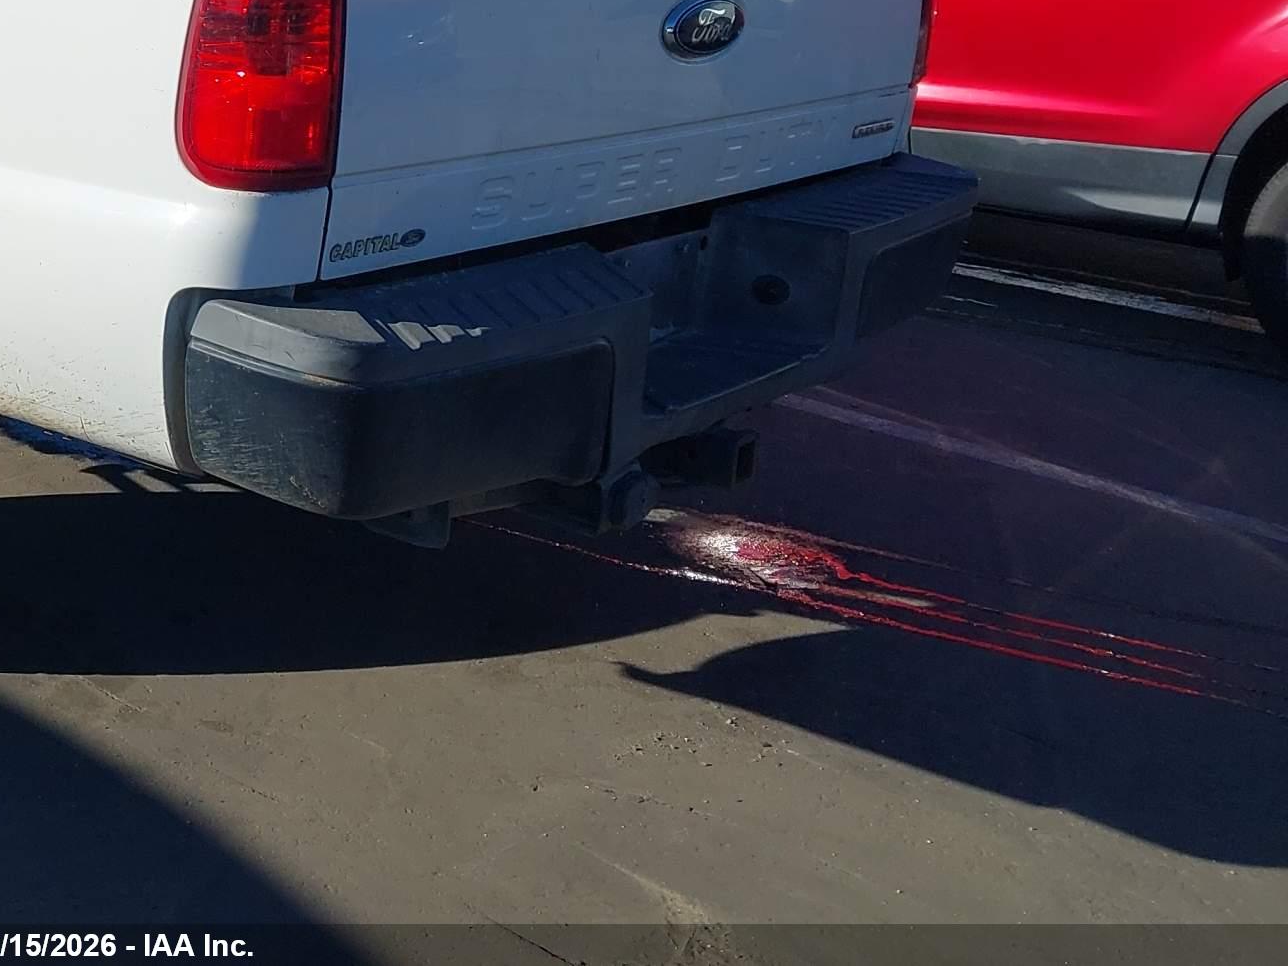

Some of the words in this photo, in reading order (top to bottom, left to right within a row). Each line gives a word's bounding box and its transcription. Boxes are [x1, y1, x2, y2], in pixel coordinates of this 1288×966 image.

[471, 146, 683, 231] SUPER
[714, 115, 839, 183] DUTY
[329, 232, 401, 263] CAPITAL
